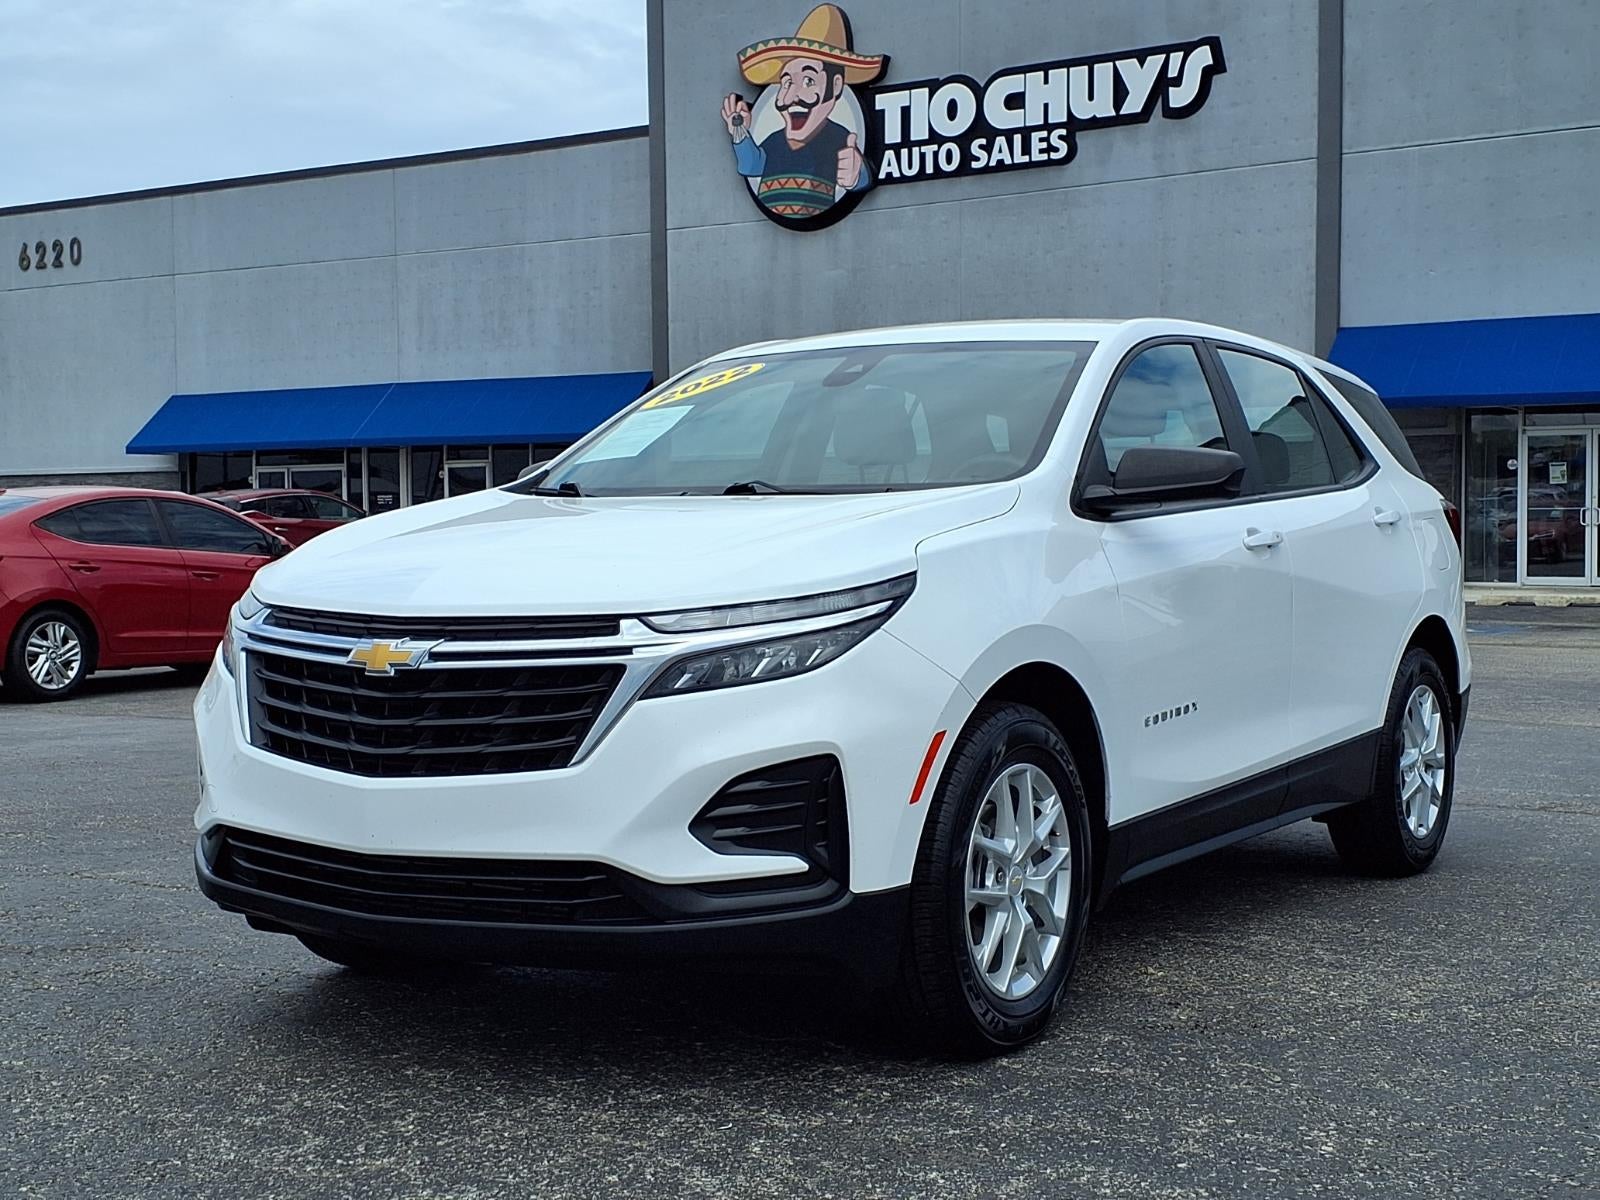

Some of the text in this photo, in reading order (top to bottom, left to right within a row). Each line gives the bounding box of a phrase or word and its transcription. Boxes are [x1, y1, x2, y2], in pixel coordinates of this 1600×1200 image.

[875, 45, 1214, 144] TIO CHUY'S
[878, 128, 1068, 179] AUTO SALES
[18, 236, 82, 272] 6220
[654, 365, 753, 405] 2022
